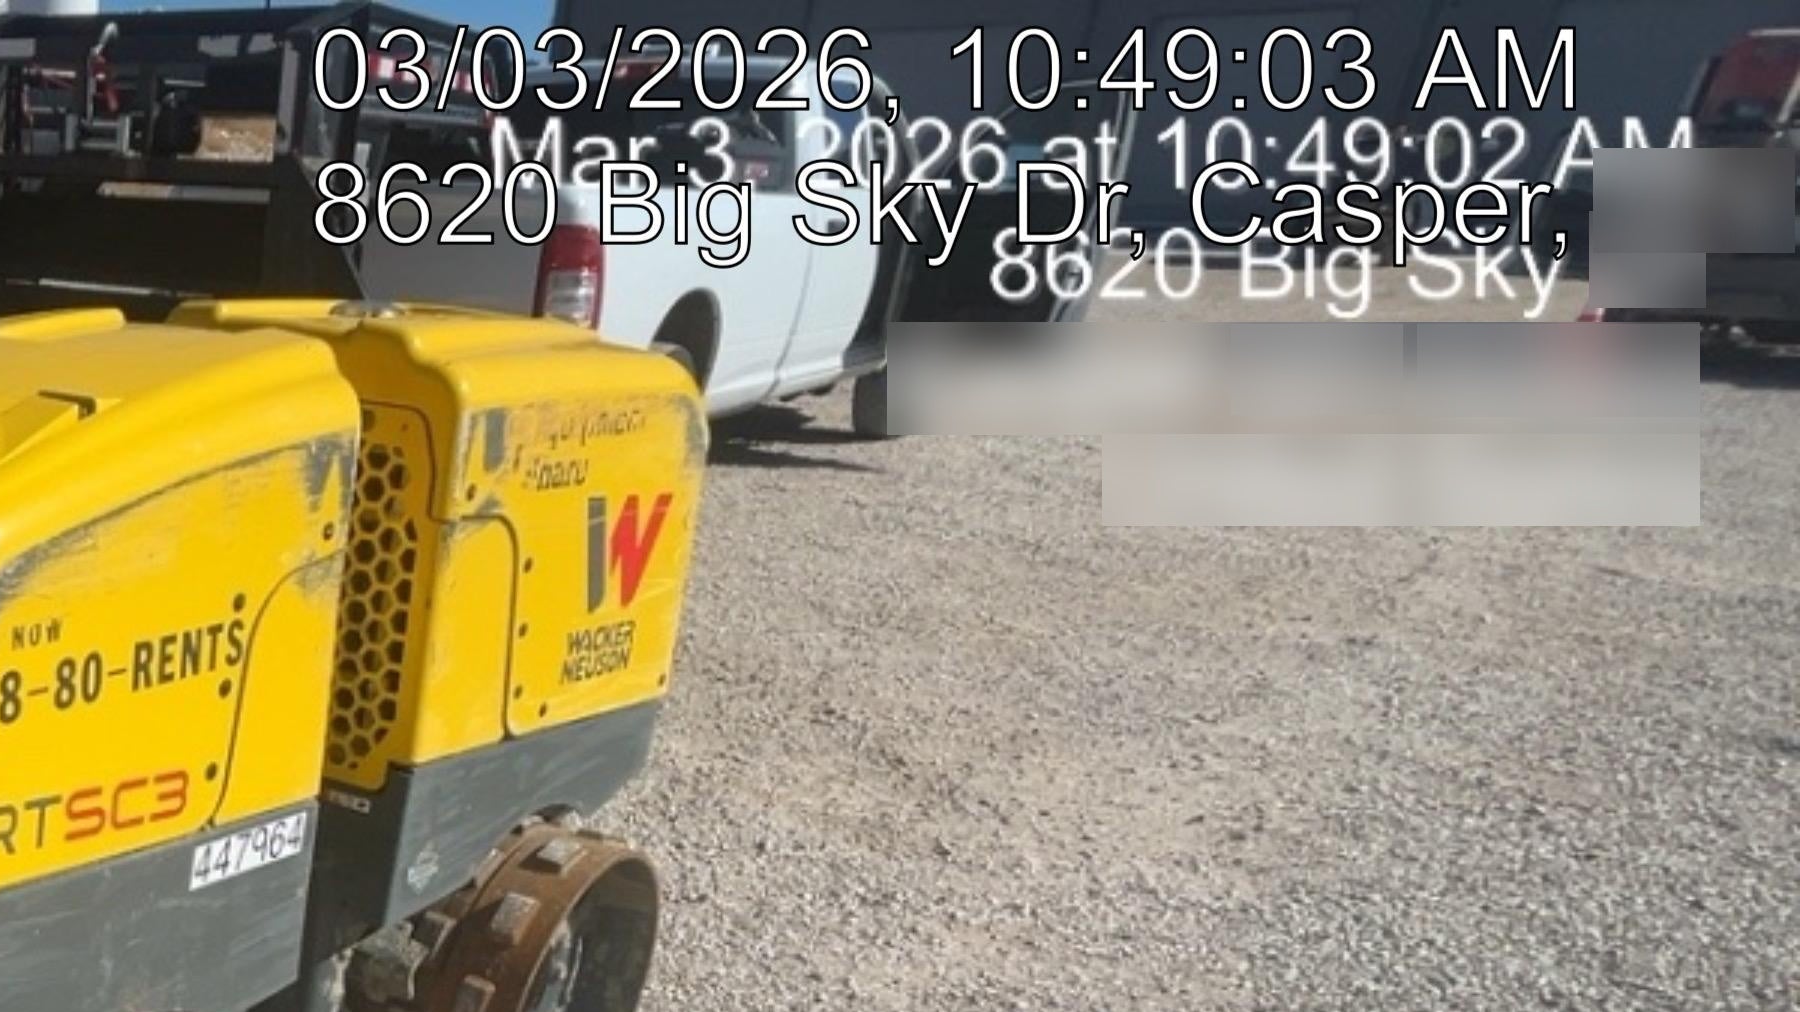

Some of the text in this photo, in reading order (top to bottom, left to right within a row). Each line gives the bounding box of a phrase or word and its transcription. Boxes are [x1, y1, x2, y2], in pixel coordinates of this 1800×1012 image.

[565, 620, 636, 656] WACKER
[560, 648, 631, 684] NEUSON
[193, 813, 303, 882] 447964
